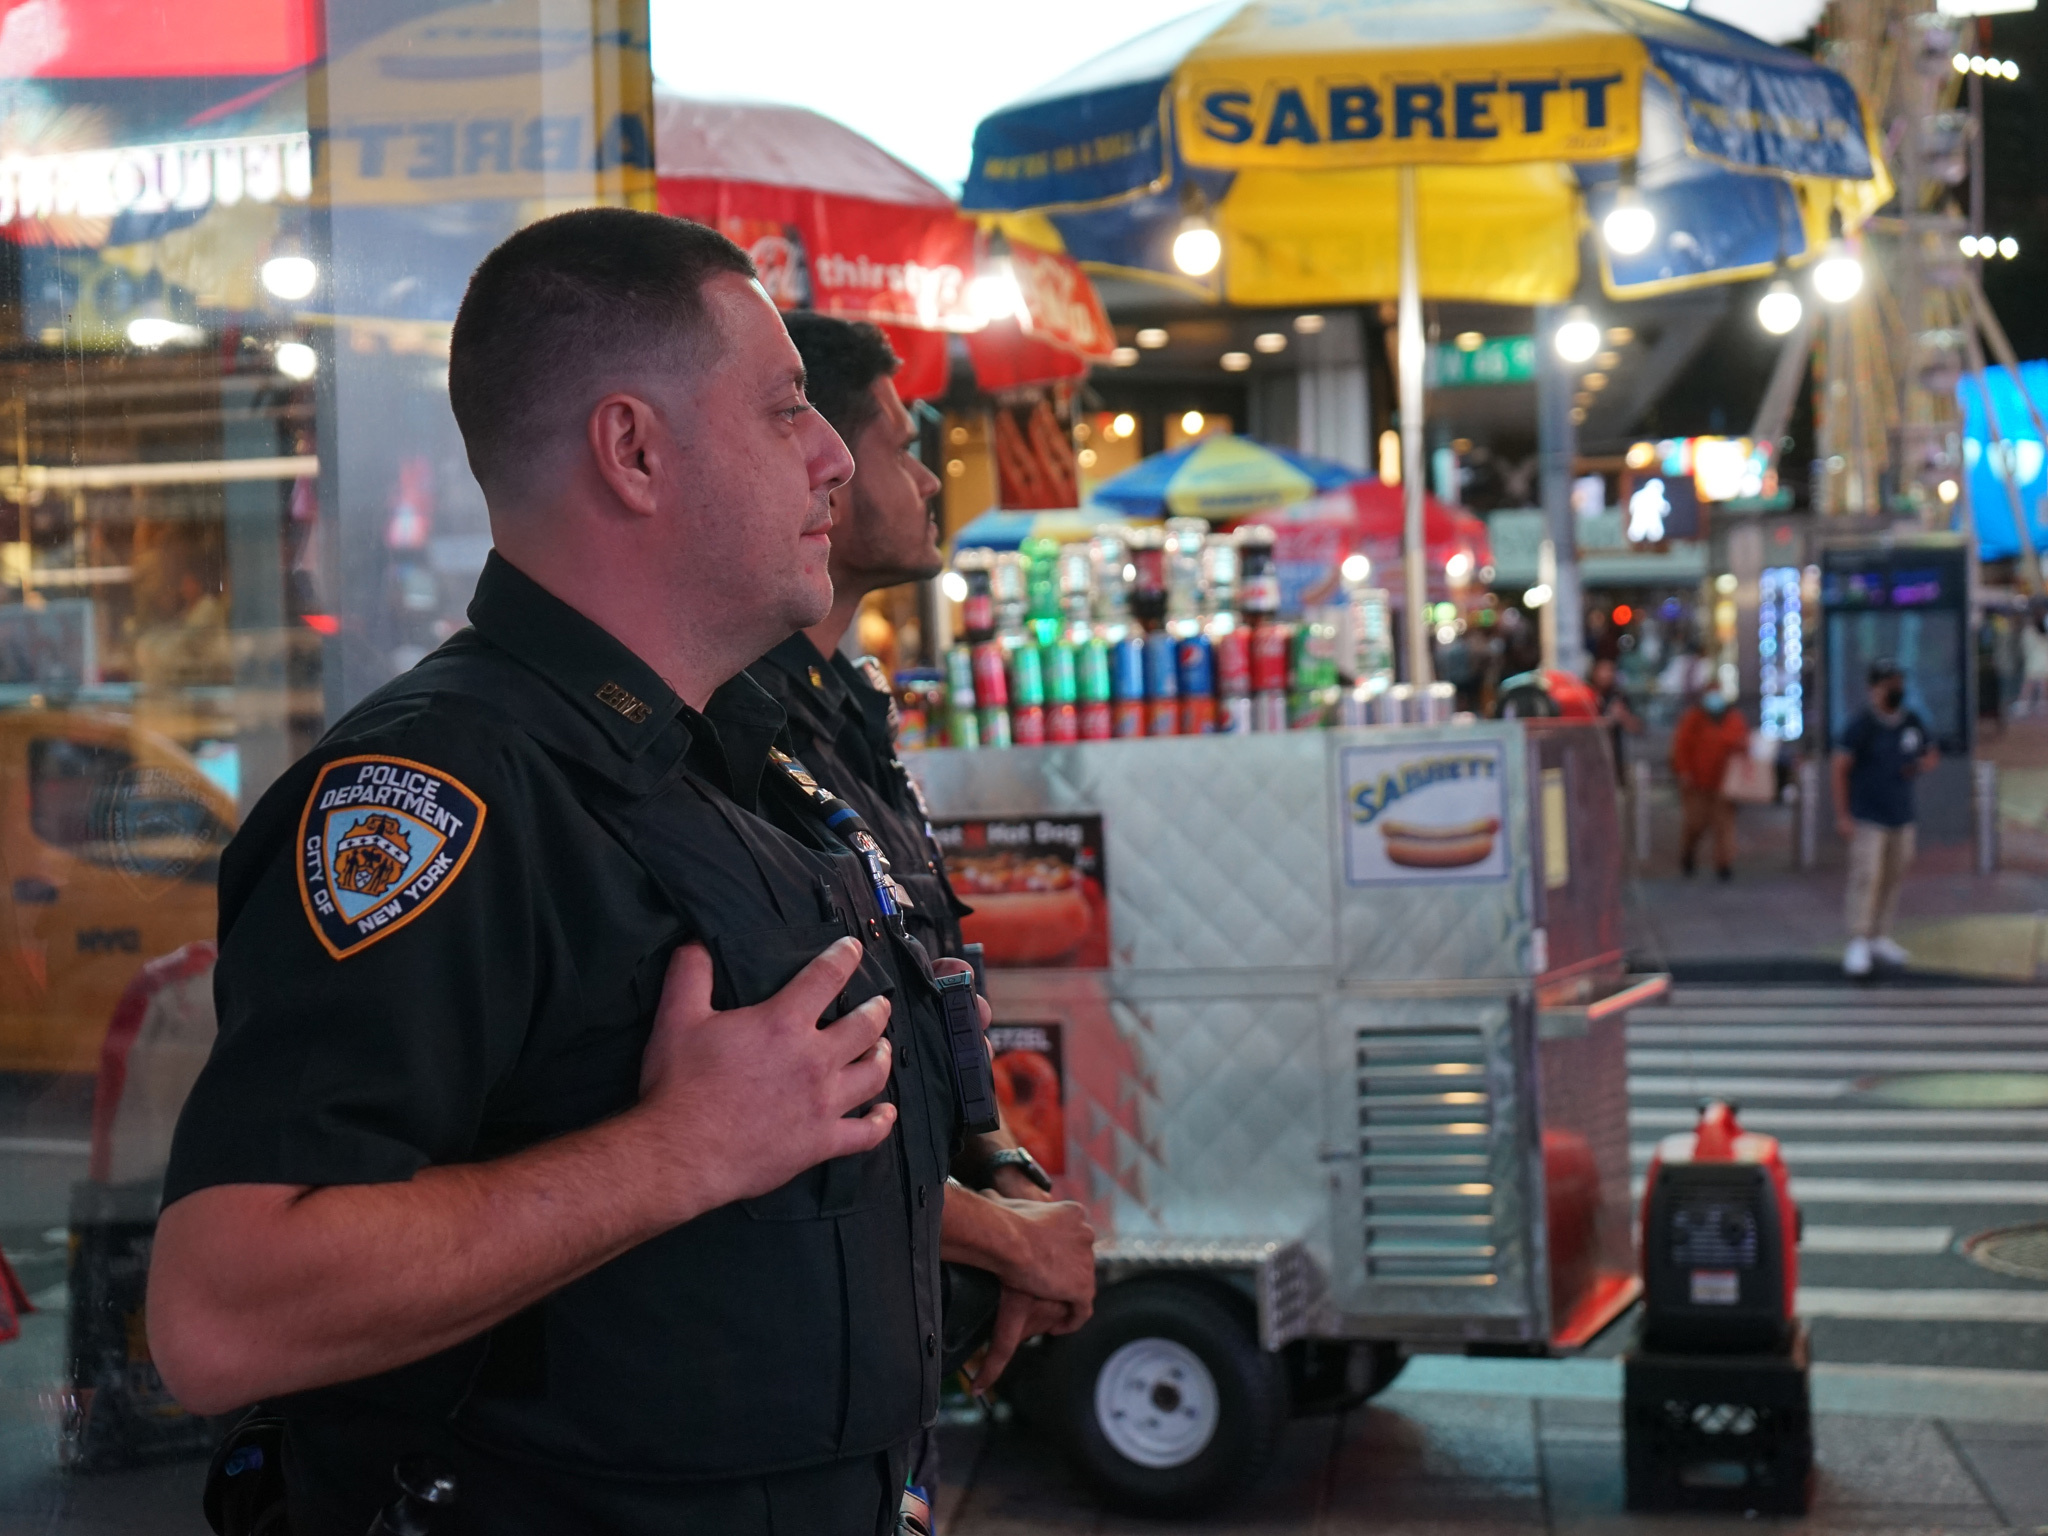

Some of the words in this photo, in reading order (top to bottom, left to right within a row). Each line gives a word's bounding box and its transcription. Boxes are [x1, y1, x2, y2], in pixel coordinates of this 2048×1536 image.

[1202, 74, 1624, 146] SABRETT
[357, 765, 441, 800] POLICE
[319, 784, 464, 838] DEPARTMENT
[307, 835, 325, 882] CITY
[313, 888, 335, 915] OF
[356, 899, 403, 934] NEW
[403, 852, 454, 900] YORK
